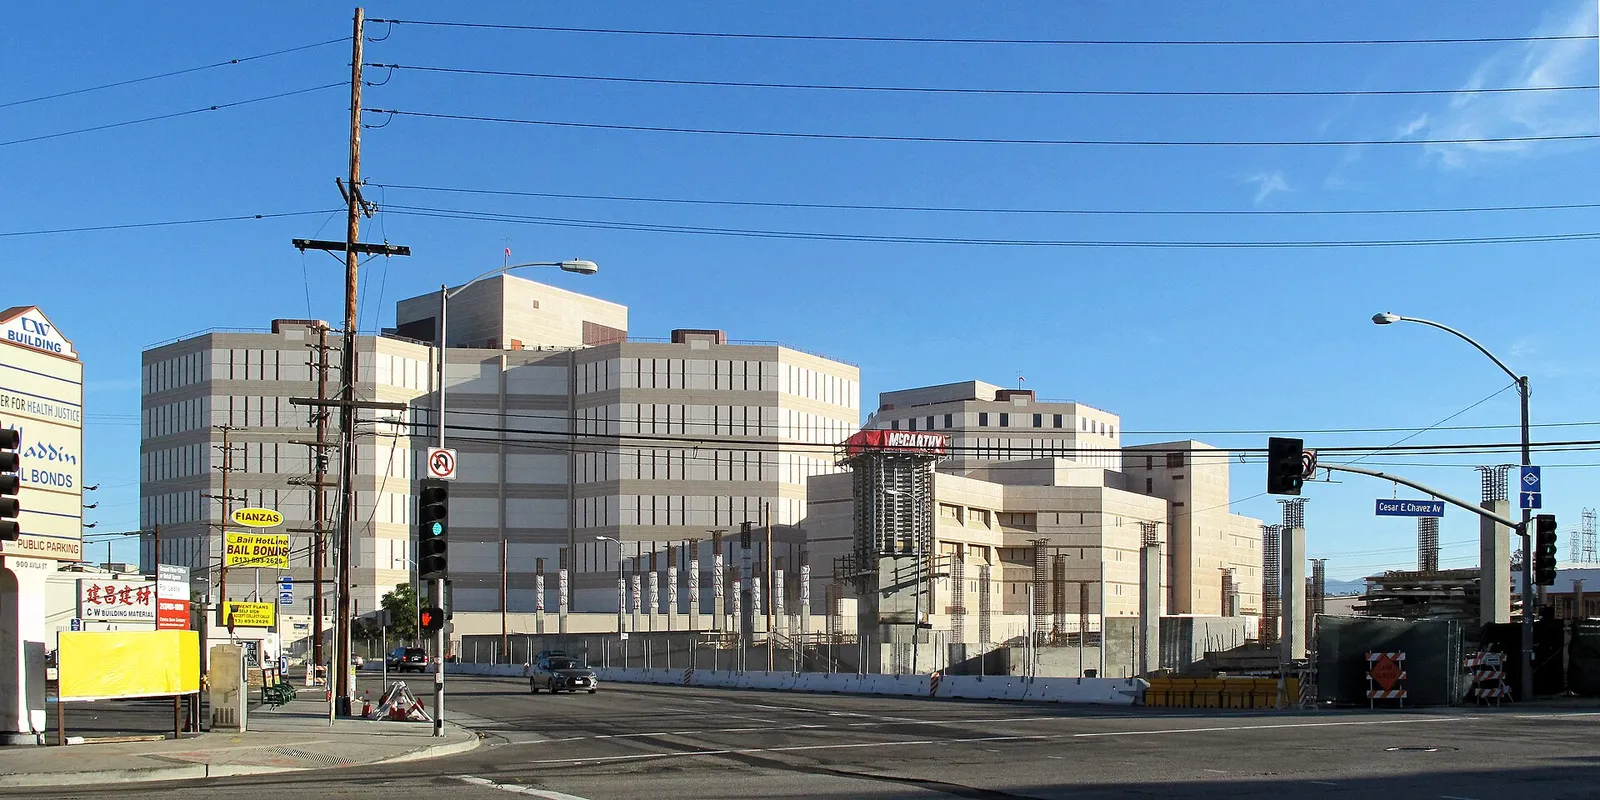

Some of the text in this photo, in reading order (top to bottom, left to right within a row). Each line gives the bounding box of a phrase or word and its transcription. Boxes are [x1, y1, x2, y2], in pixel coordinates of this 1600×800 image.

[8, 330, 61, 352] BUILDING
[11, 397, 26, 411] FOR
[27, 400, 53, 417] HEALTH
[54, 406, 80, 422] JUSTICE
[10, 423, 77, 465] laddin
[31, 469, 73, 488] BONDS
[1379, 503, 1399, 512] Cesar
[1407, 504, 1431, 513] Chavez
[1432, 505, 1441, 513] Av
[235, 512, 279, 522] FIANZAS
[17, 538, 79, 554] PUBLIC PARKING
[236, 536, 288, 545] Bail HotLine
[227, 544, 288, 557] BAIL BONDS
[16, 560, 28, 569] 900
[232, 556, 250, 564] (213)
[87, 583, 157, 606] 建昌建材
[87, 607, 92, 616] C
[94, 608, 101, 617] W
[128, 610, 154, 618] MATERIAL
